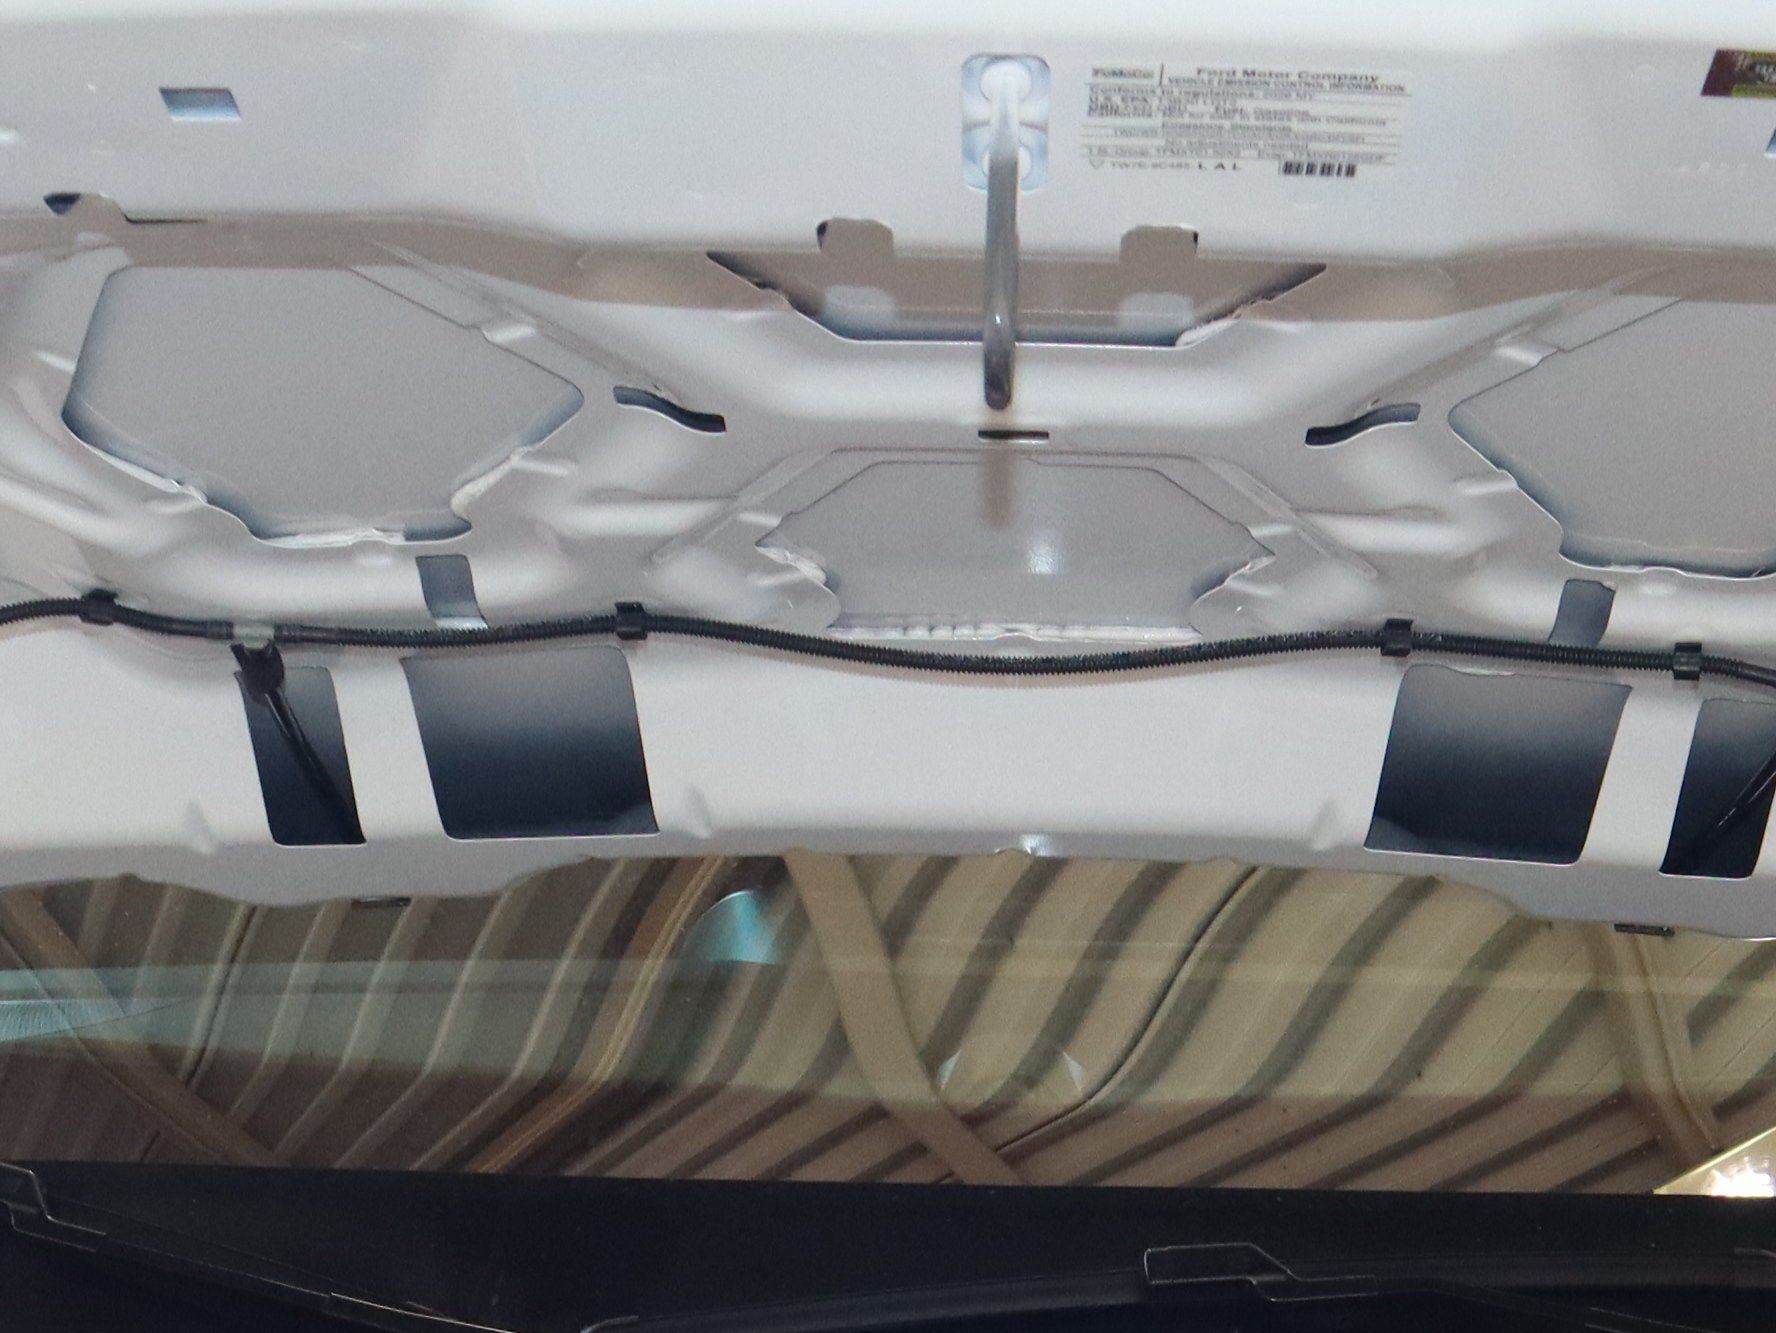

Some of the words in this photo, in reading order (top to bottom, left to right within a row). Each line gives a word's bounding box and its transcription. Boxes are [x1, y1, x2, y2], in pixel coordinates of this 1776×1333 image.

[1196, 67, 1237, 77] Ford
[1242, 69, 1291, 80] Motor
[1297, 71, 1379, 83] Company
[1217, 78, 1271, 88] EMISSION
[1274, 79, 1324, 90] CONTROL
[1328, 82, 1406, 92] INFORMATION
